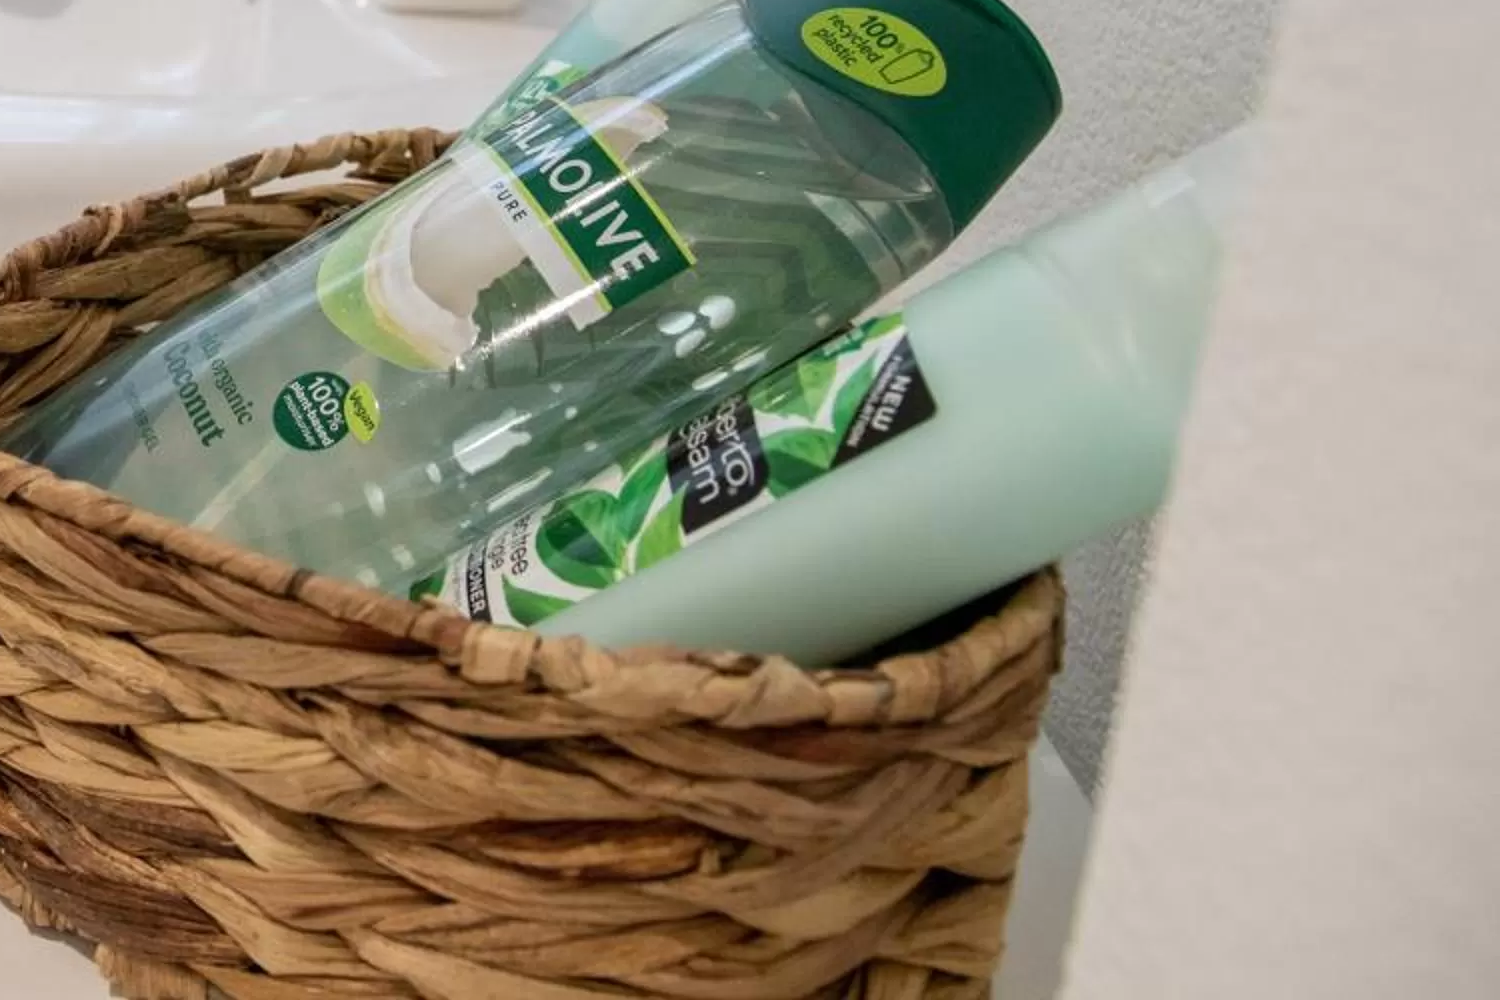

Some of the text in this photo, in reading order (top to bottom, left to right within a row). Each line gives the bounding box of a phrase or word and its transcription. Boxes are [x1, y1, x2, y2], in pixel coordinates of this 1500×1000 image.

[812, 28, 859, 67] plastic
[827, 14, 884, 64] recycled
[493, 180, 529, 223] PURE
[502, 109, 660, 282] PALMOLIVE
[163, 341, 225, 448] Coconut
[211, 358, 253, 425] organic
[307, 375, 344, 432] 100%
[871, 375, 912, 432] NEW
